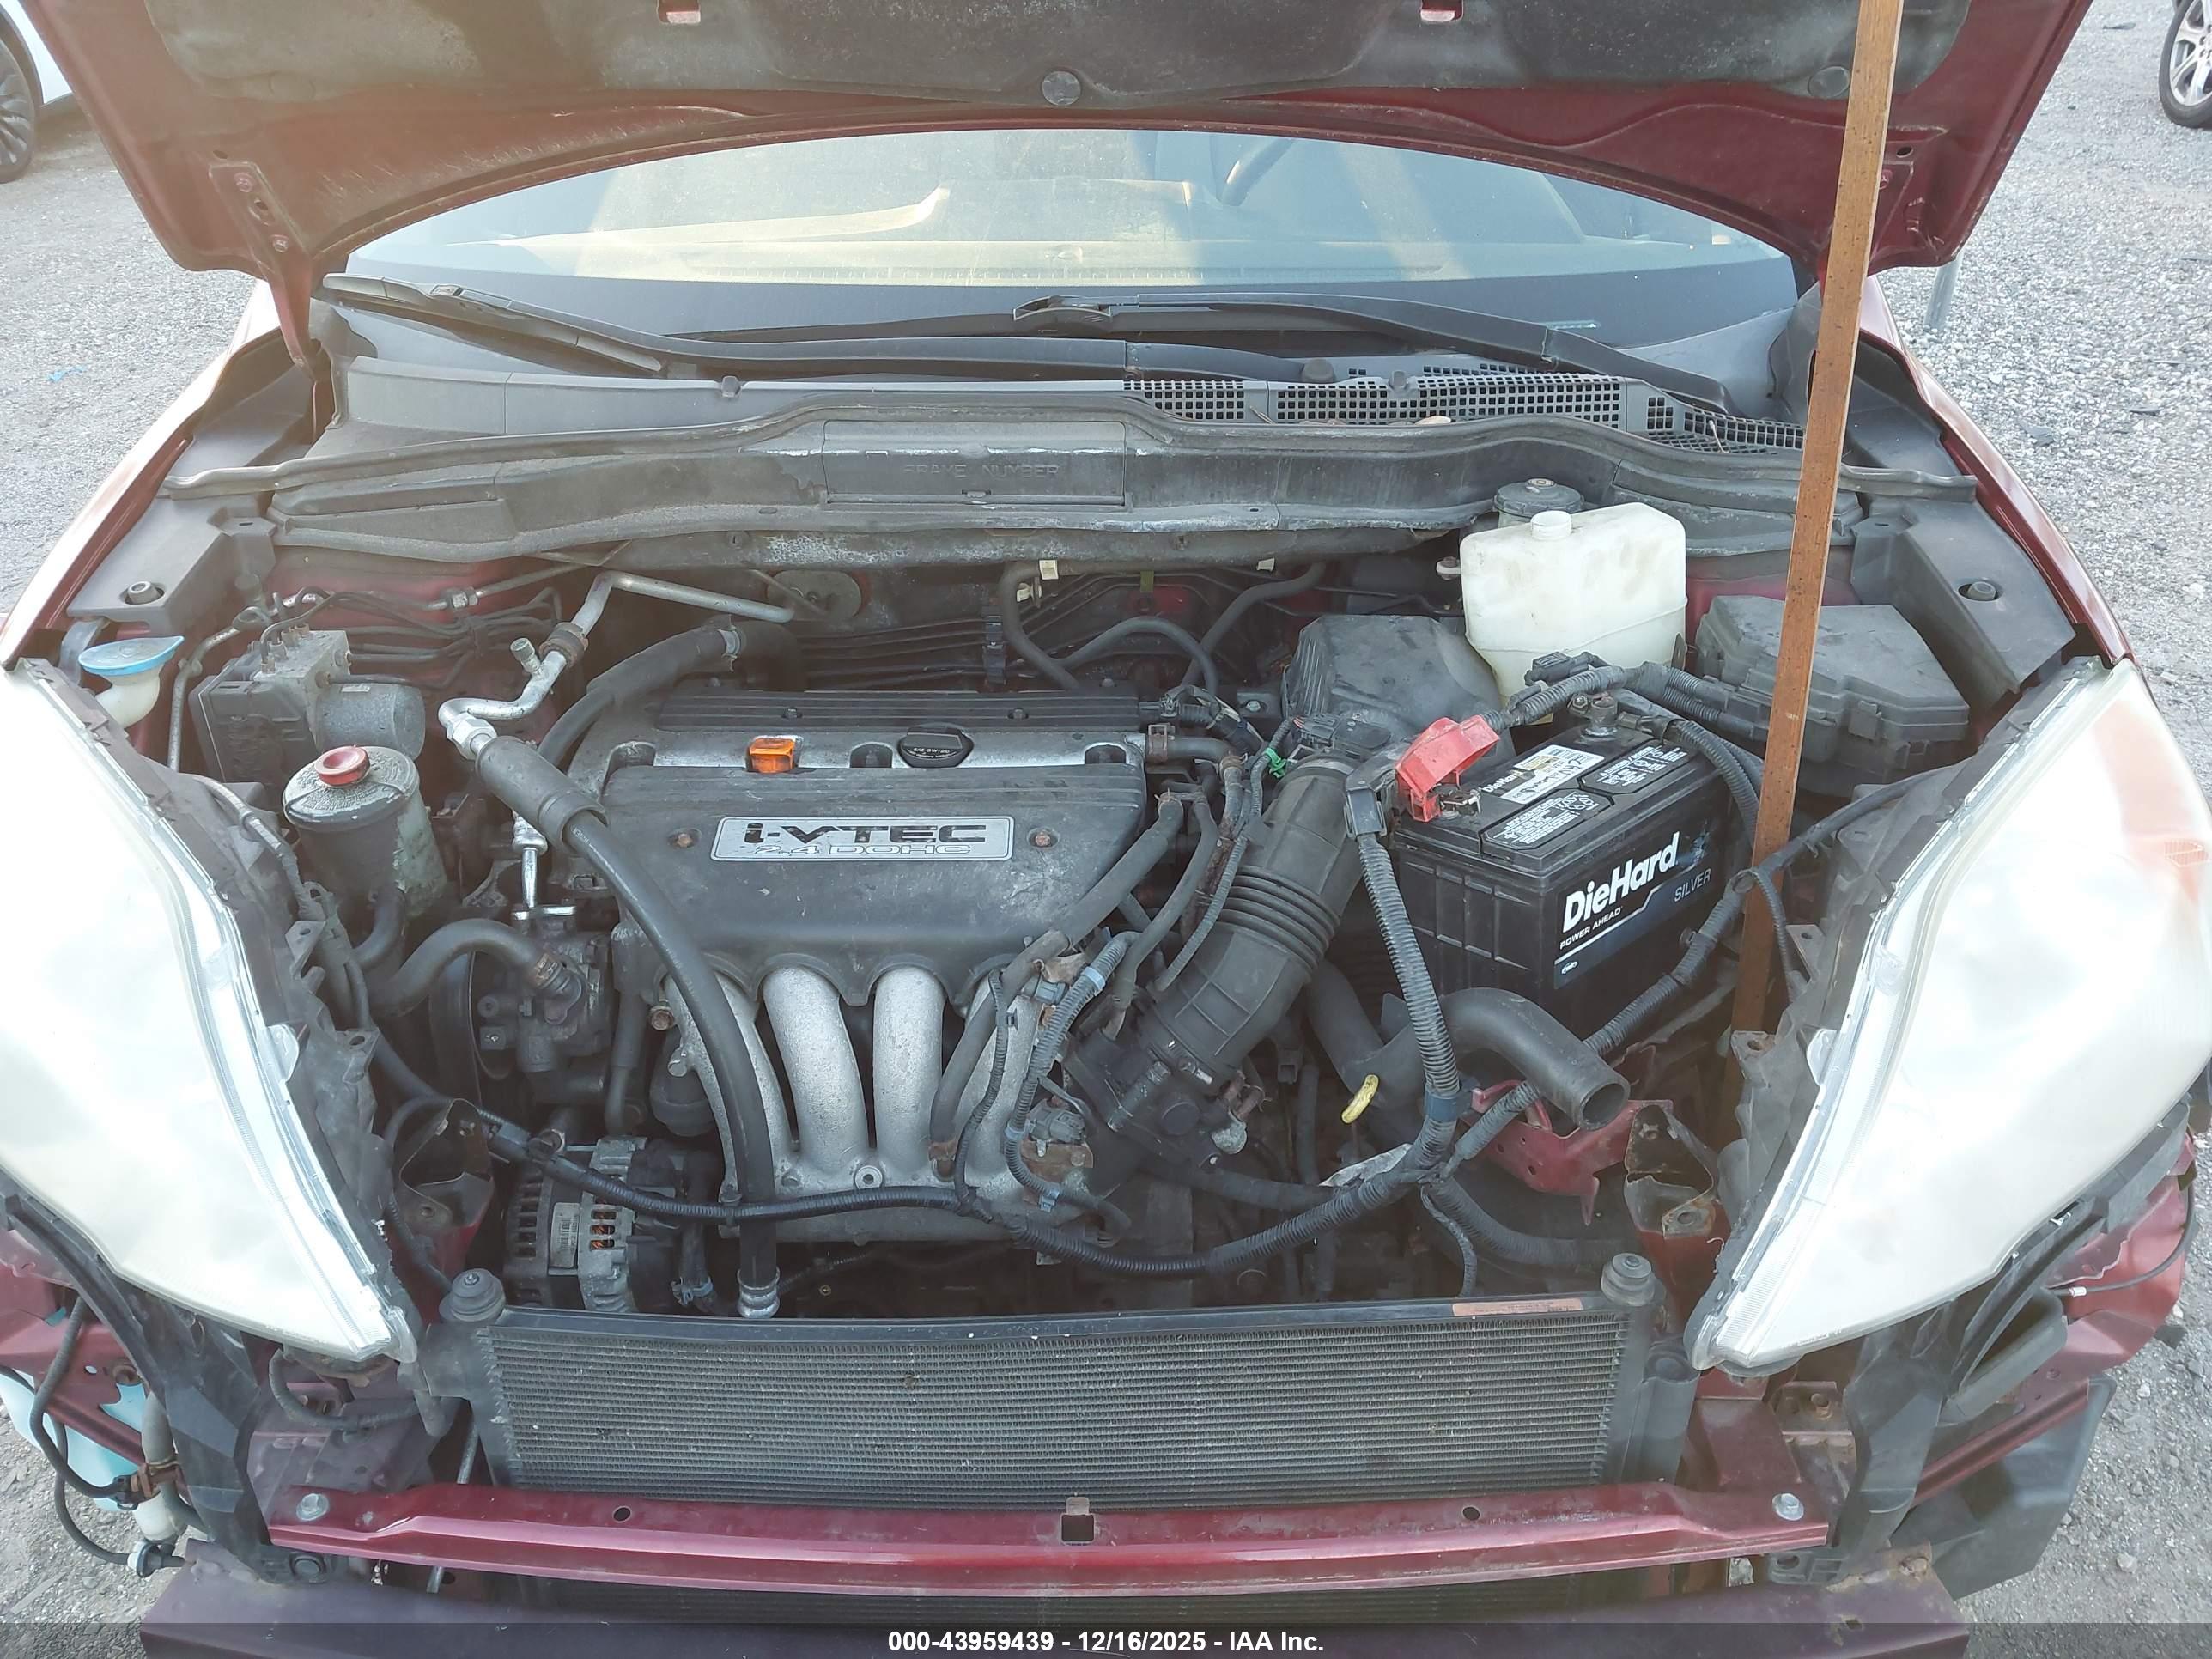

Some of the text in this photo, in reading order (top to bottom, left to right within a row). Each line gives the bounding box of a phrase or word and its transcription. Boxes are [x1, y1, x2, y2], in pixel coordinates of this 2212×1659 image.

[982, 464, 1060, 478] NUMBER
[1483, 770, 1523, 793] DieHard
[754, 844, 971, 856] 2.4 DOHC
[1562, 830, 1680, 933] DieHard
[1674, 867, 1711, 903] SILVER
[1559, 906, 1622, 951] POWER AHEAD
